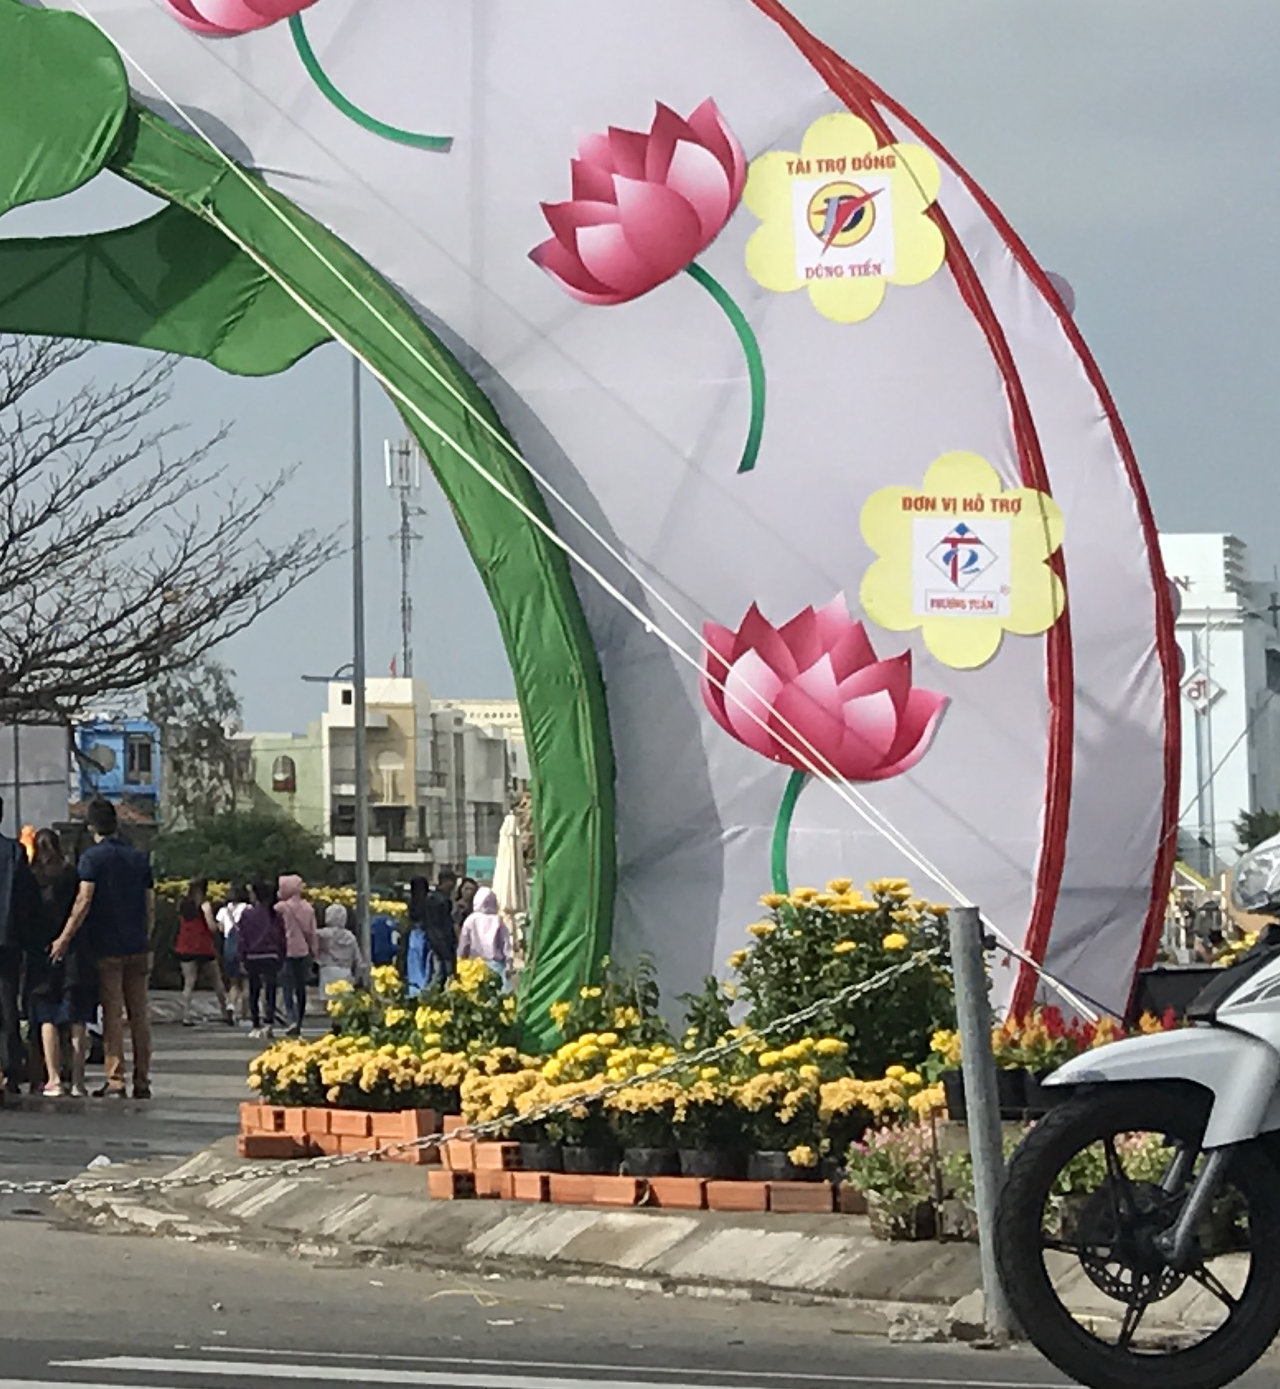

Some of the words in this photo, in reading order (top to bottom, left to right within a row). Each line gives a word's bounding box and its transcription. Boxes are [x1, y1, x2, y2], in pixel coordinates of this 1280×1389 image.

[786, 159, 811, 175] TÀI
[816, 157, 847, 175] TRỢ
[901, 496, 937, 511] ĐƠN
[941, 497, 957, 514] VỊ
[962, 493, 985, 512] HỖ
[989, 497, 1022, 517] TRỢ
